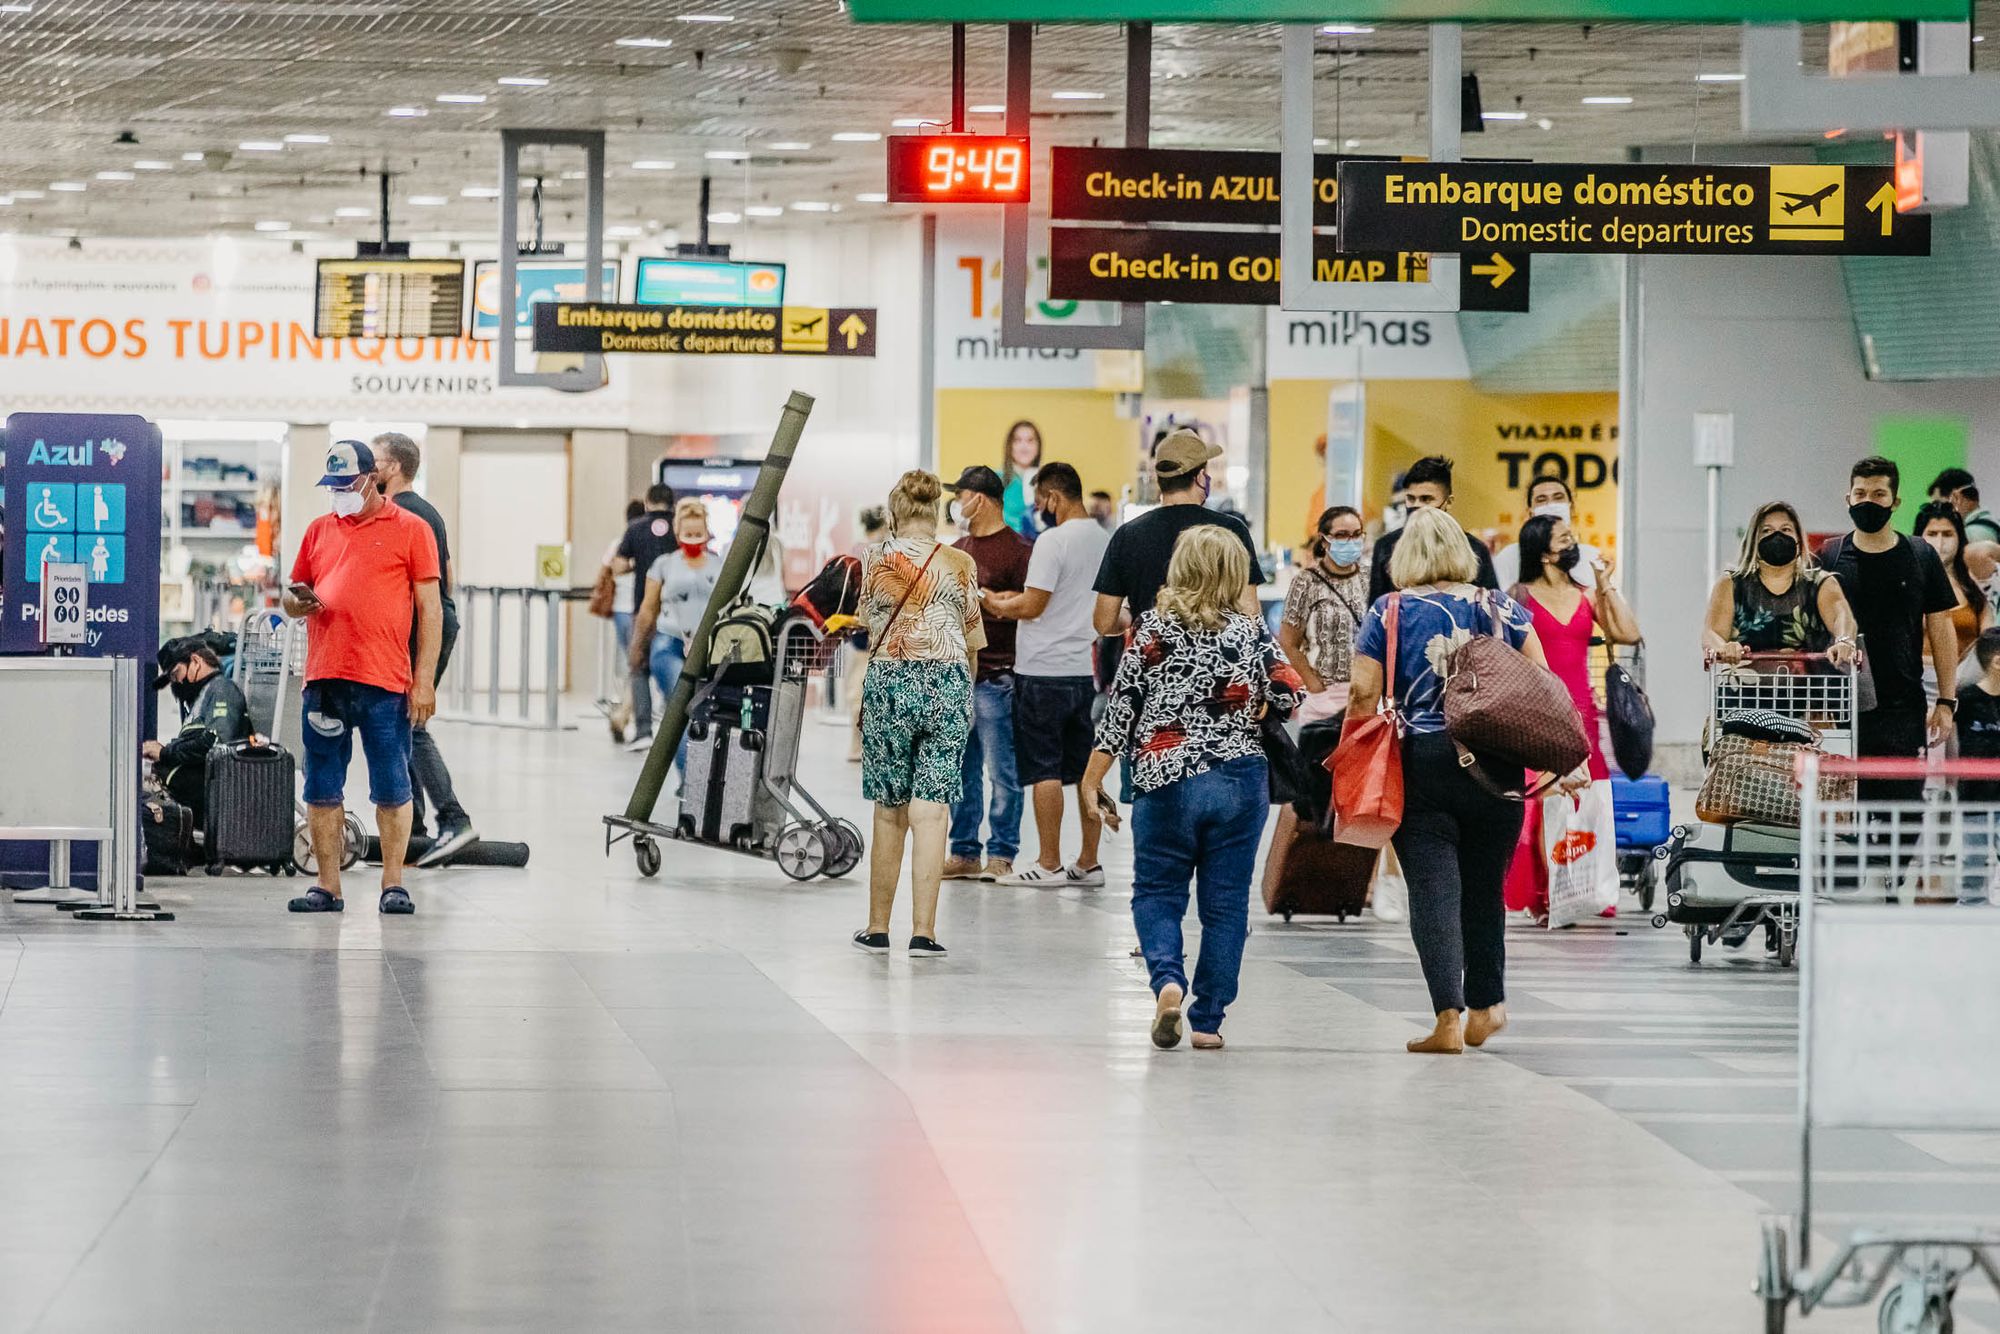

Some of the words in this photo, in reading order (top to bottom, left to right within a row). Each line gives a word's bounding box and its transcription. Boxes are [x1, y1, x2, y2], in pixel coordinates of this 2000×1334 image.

[928, 147, 1021, 190] 9:49
[1085, 171, 1202, 199] Check-in
[1210, 175, 1281, 201] AZUL
[1385, 173, 1563, 211] Embarque
[1574, 174, 1755, 206] doméstico
[1462, 216, 1593, 242] Domestic
[1602, 216, 1754, 249] departures
[1089, 252, 1219, 280] Check-in
[1317, 257, 1386, 282] MAP
[557, 305, 664, 332] Embarque
[667, 307, 777, 331] doméstico
[601, 331, 680, 351] Domestic
[683, 332, 775, 354] departures
[352, 376, 492, 394] SOUVENIRS
[1496, 424, 1584, 440] VIAJAR
[27, 438, 94, 467] Azul
[1497, 451, 1618, 489] TOD
